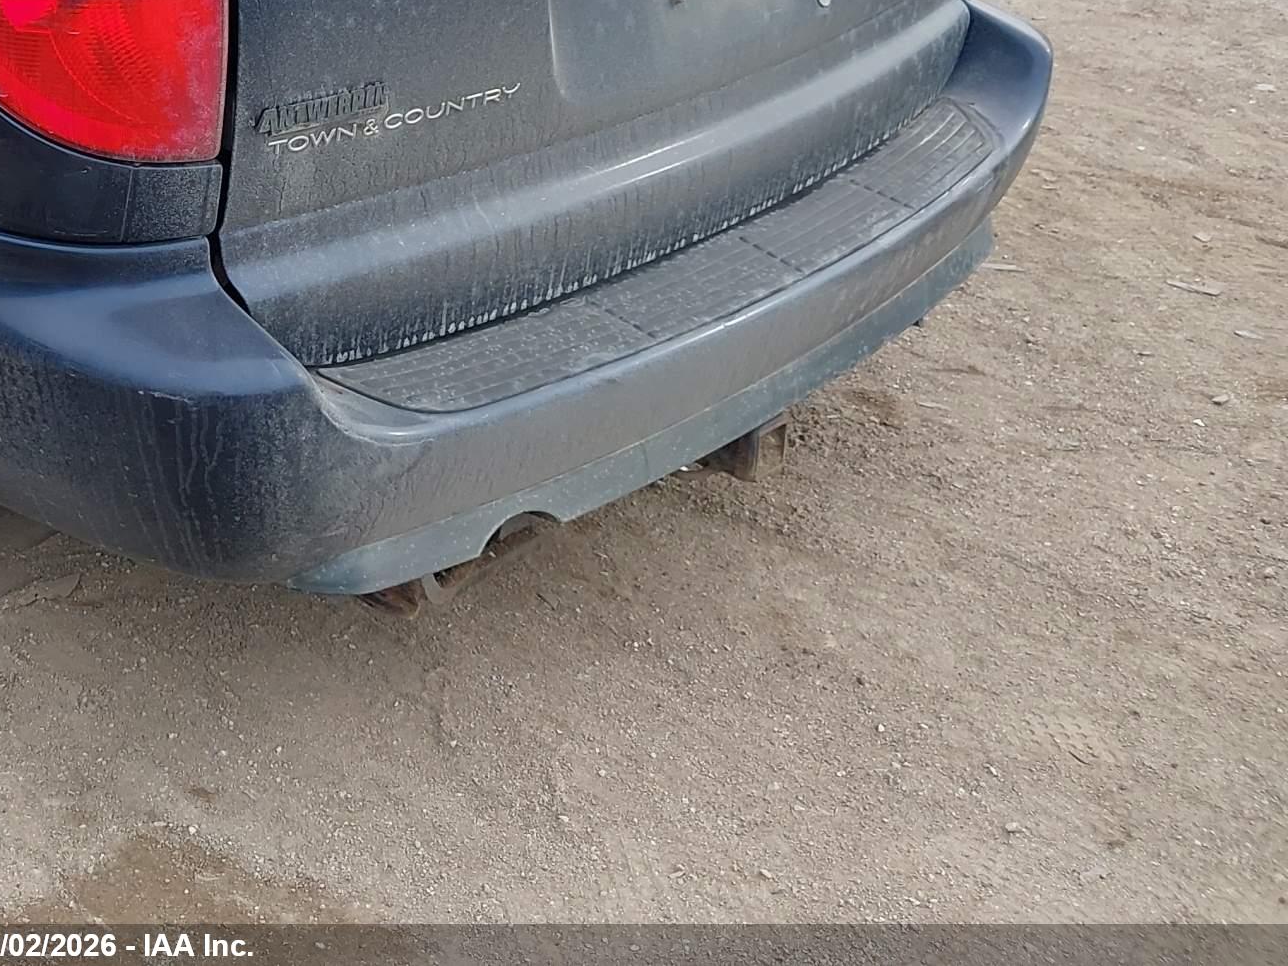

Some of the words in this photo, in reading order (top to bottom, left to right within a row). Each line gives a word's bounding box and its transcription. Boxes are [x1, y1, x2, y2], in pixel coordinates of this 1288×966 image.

[268, 123, 357, 155] TOWN
[363, 118, 379, 136] &
[383, 82, 521, 129] COUNTRY
